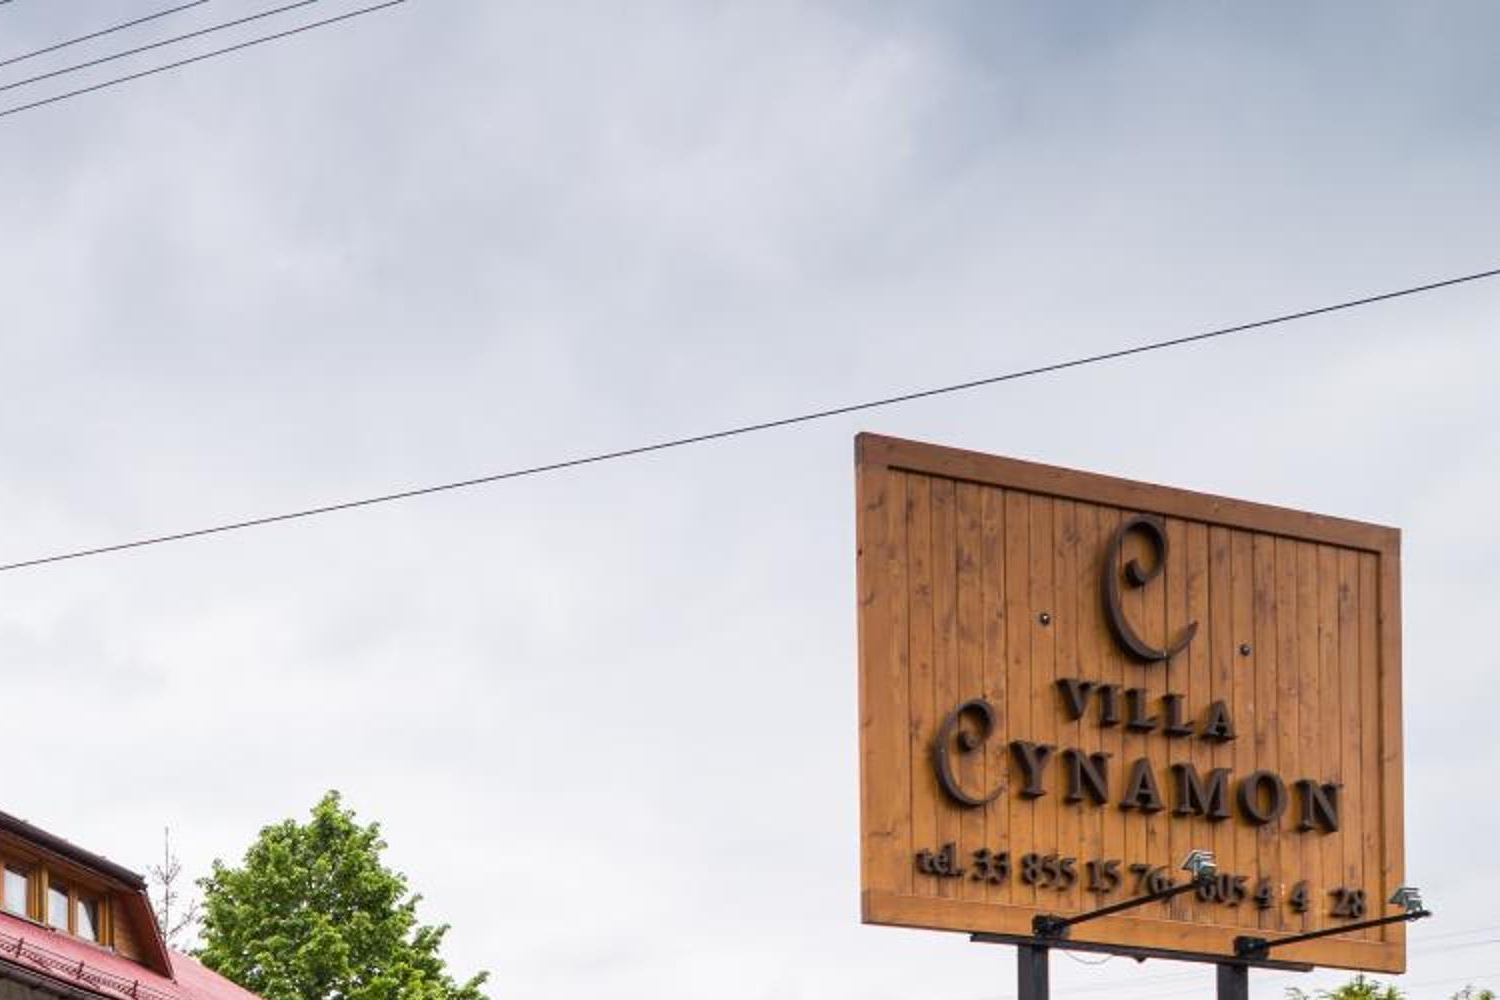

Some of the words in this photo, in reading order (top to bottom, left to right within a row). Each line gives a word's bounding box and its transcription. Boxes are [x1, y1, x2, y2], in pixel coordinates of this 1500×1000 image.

[1056, 677, 1237, 742] VILLA
[932, 698, 1344, 833] CYNAMON
[914, 842, 965, 878] tel.
[971, 849, 1011, 885] 33
[1020, 852, 1077, 892] 855
[1085, 859, 1122, 894] 15
